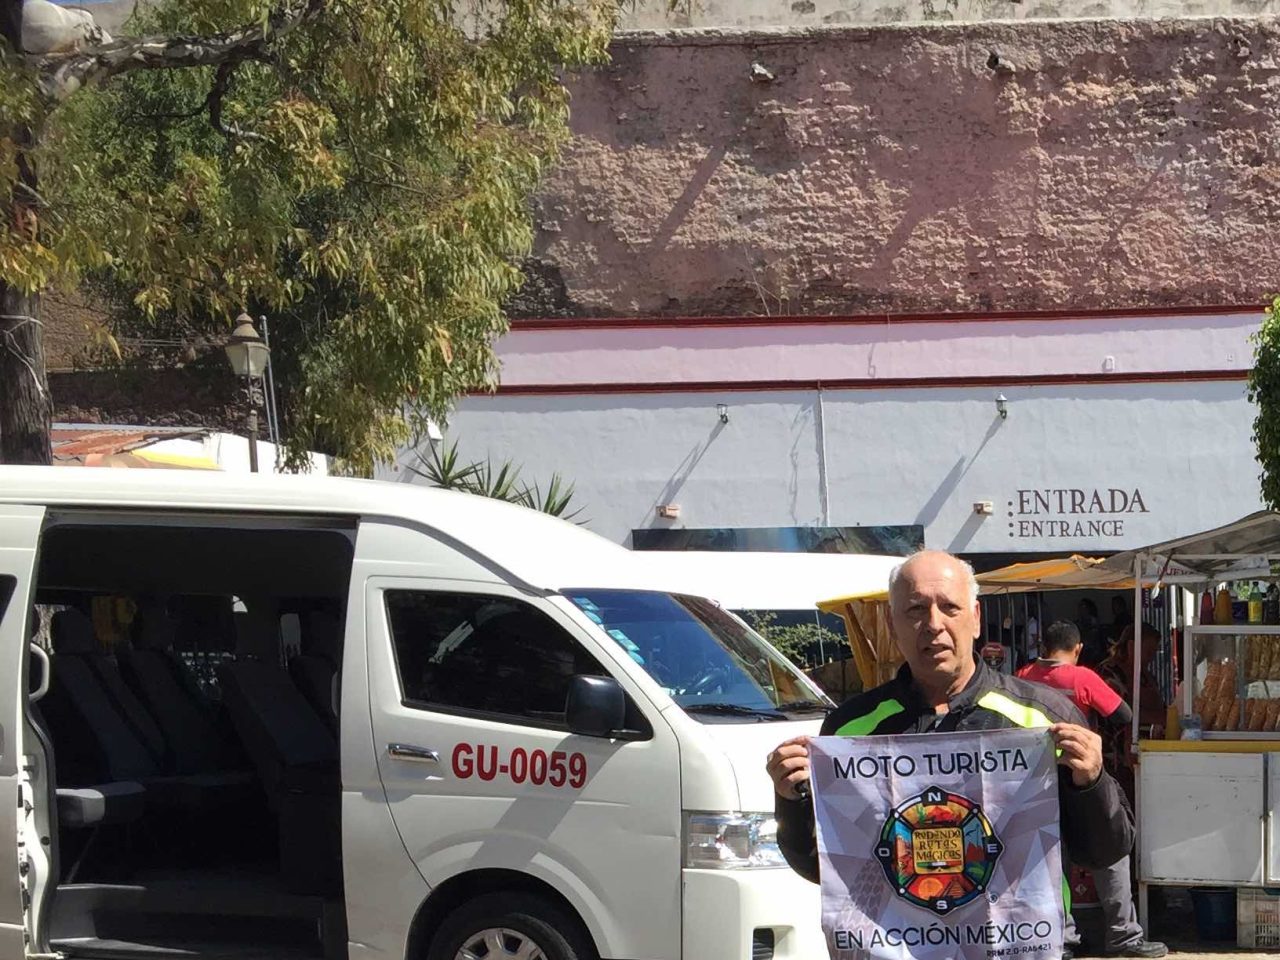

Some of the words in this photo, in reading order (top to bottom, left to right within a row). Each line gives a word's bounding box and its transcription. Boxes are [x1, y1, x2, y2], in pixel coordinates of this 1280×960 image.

[1017, 488, 1150, 515] ENTRADA
[1018, 520, 1124, 538] ENTRANCE
[452, 743, 587, 789] GU-0059
[833, 755, 916, 779] MOTO
[923, 749, 1028, 775] TURISTA
[928, 792, 941, 802] N
[987, 843, 998, 853] E
[936, 900, 948, 910] S
[835, 931, 863, 949] EN
[870, 922, 960, 947] ACCIÓN
[967, 920, 1052, 945] MÉXICO
